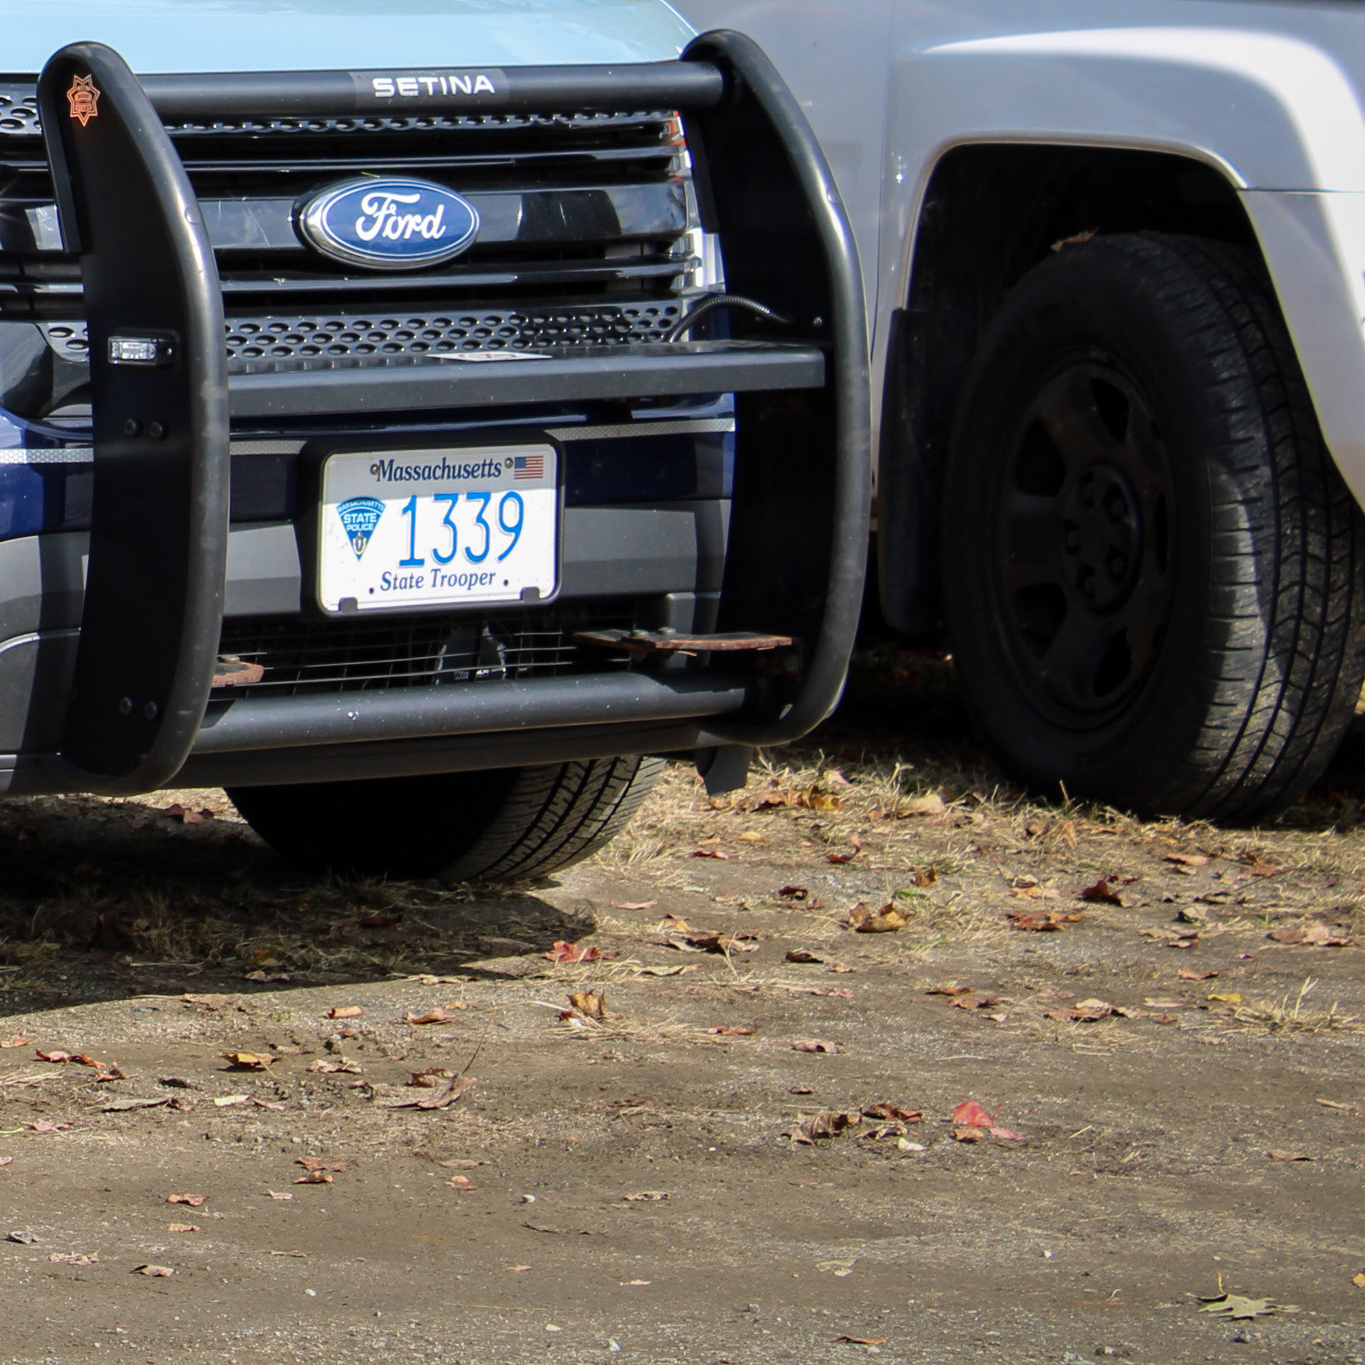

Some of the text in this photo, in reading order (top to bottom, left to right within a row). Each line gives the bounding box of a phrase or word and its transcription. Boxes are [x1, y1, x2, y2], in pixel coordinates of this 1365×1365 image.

[372, 74, 496, 97] SETINA
[355, 192, 447, 241] Ford
[376, 456, 503, 483] Massachusetts
[343, 513, 377, 524] STATE
[346, 523, 375, 532] POLICE
[398, 490, 525, 568] 1339
[380, 568, 497, 592] State Trooper
